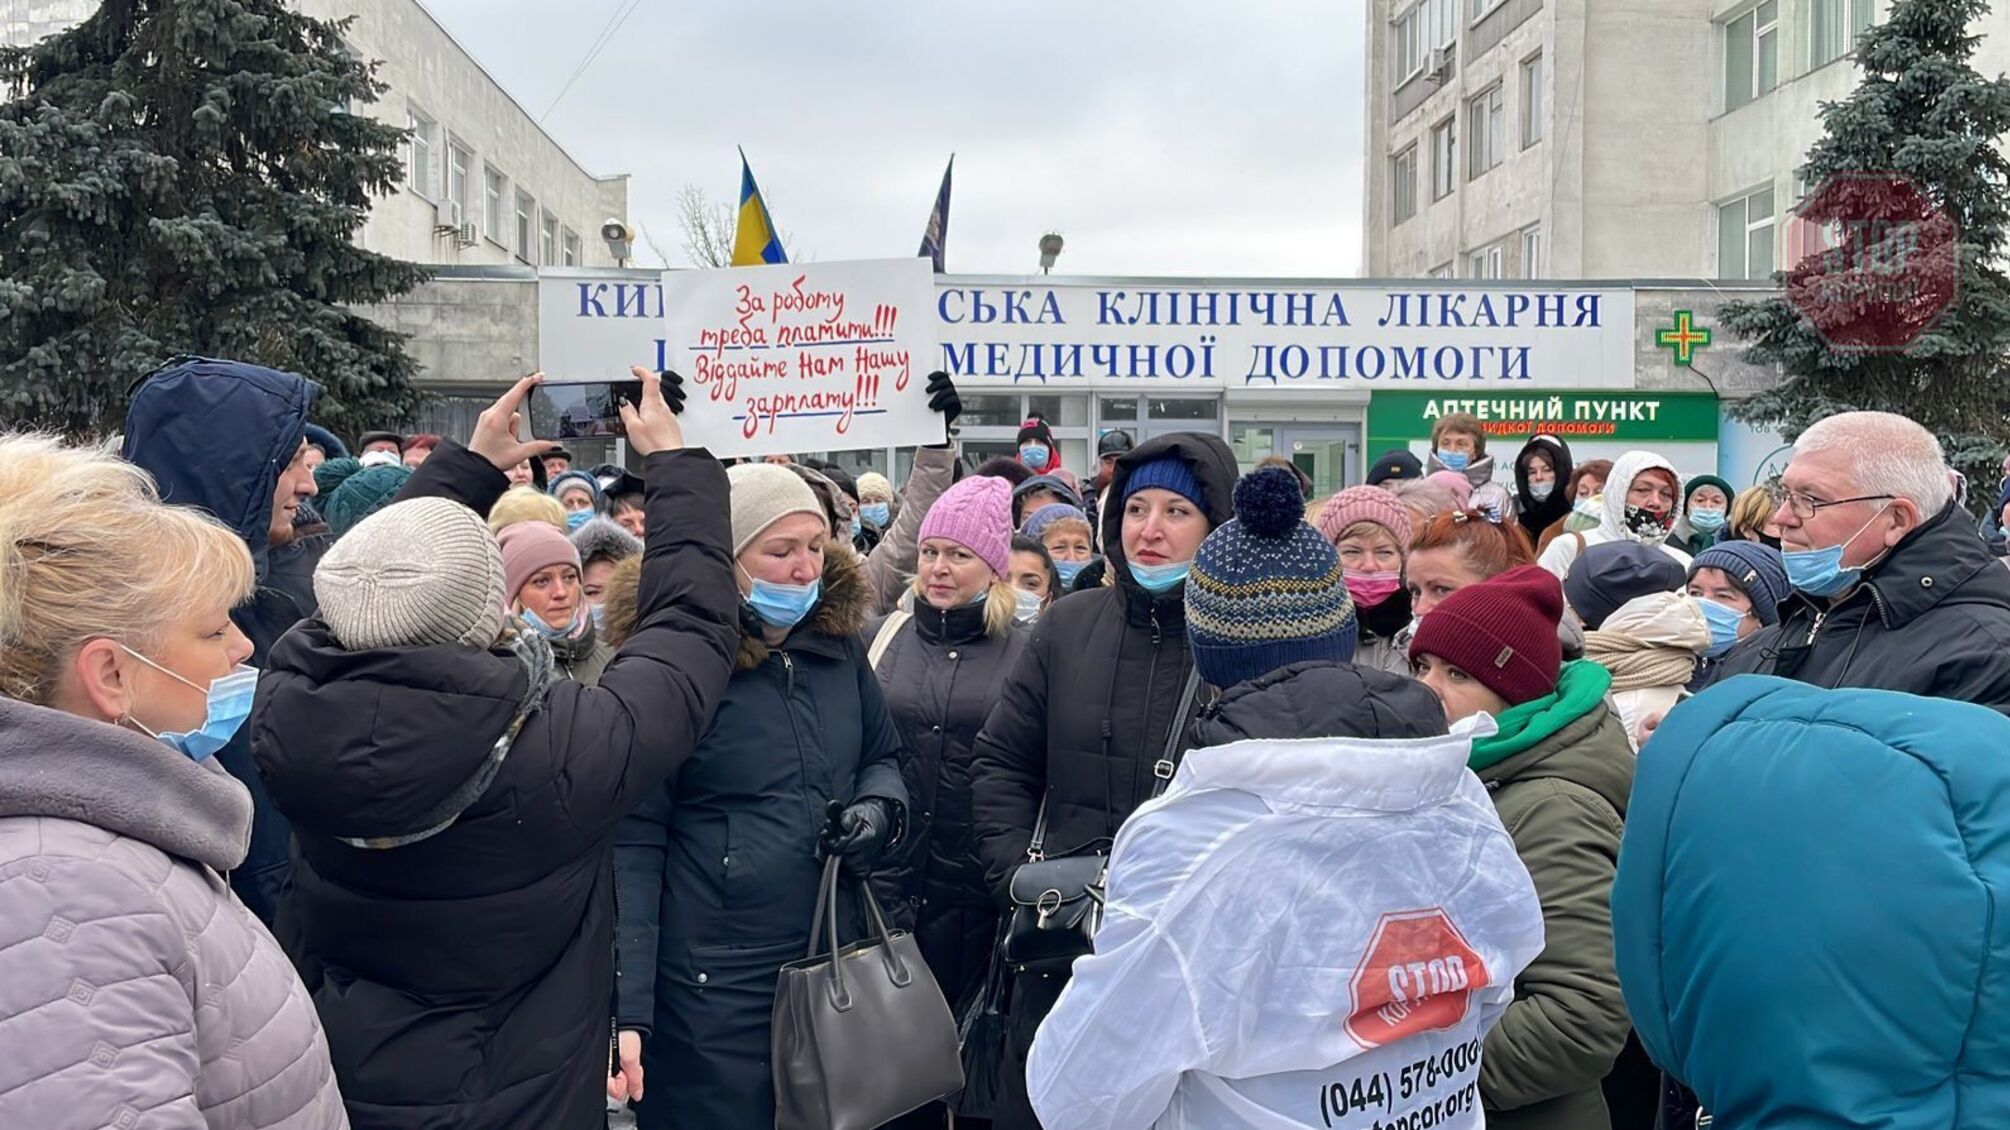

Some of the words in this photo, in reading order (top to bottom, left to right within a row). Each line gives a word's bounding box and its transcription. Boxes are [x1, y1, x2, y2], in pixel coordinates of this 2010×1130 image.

[736, 285, 766, 314] За
[772, 275, 844, 323] роботу
[938, 289, 1066, 324] СЬКА
[1096, 291, 1351, 326] КЛІНІЧНА
[1379, 293, 1602, 328] ЛІКАРНЯ
[700, 312, 767, 360] треба
[777, 304, 897, 346] платити!!!
[694, 354, 787, 400] Віддайте
[800, 350, 843, 379] Нам
[855, 346, 909, 391] Нашу
[940, 335, 1216, 384] МЕДИЧНОЇ
[1245, 345, 1533, 385] ДОПОМОГИ
[743, 375, 880, 439] зарплату!!!
[1423, 396, 1563, 420] АПТЕЧНИЙ
[1574, 401, 1660, 420] ПУНКТ
[1537, 422, 1616, 435] ДОПОМОГИ
[1320, 1072, 1392, 1128] (044)
[1400, 1036, 1482, 1099] 578-000
